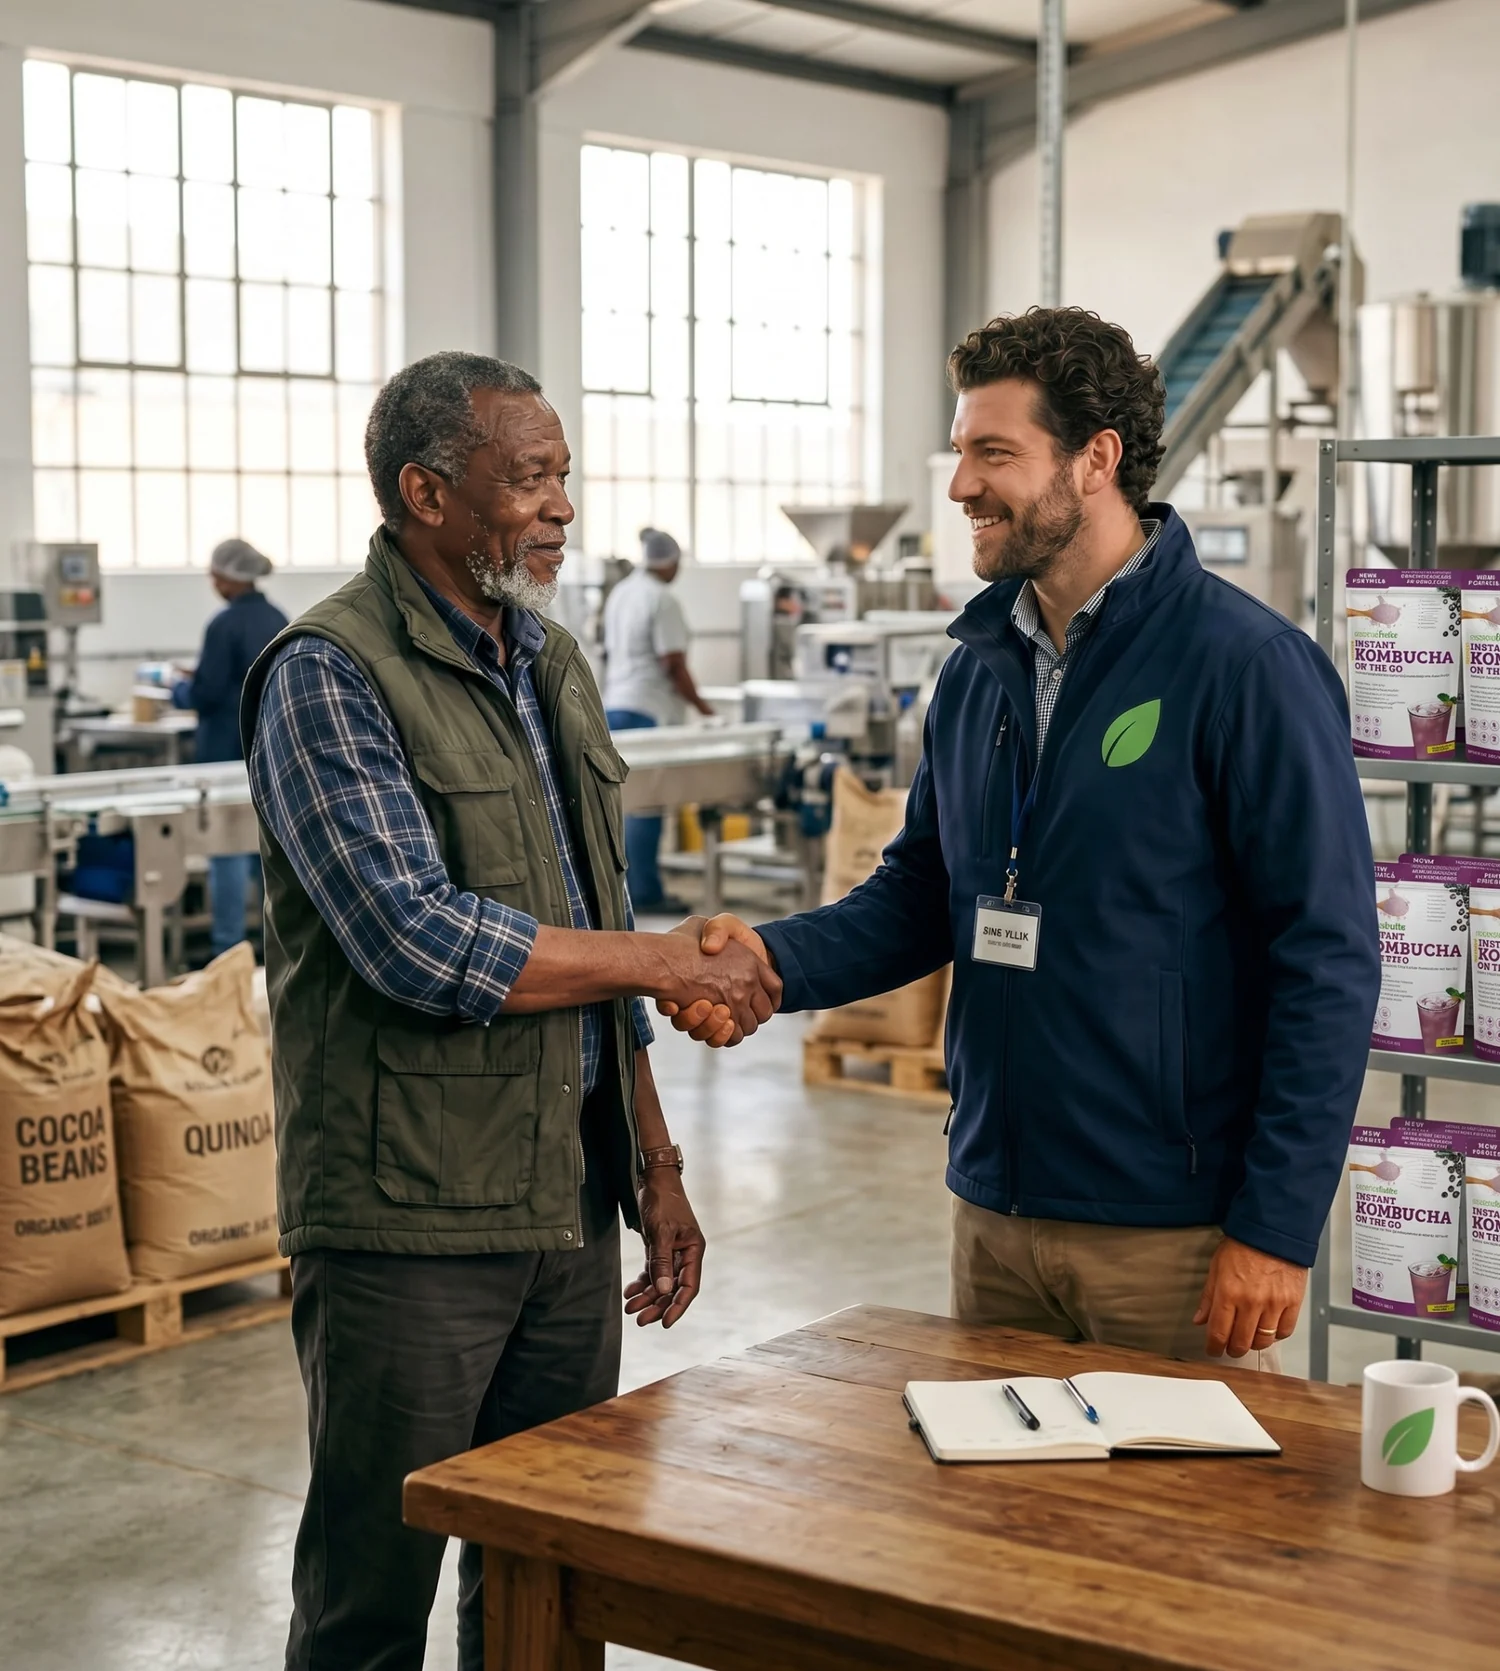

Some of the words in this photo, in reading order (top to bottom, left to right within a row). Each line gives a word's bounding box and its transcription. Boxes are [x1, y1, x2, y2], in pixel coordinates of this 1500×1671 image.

[1355, 640, 1396, 649] INSTANT
[1355, 648, 1454, 664] KOMBUCHA
[1470, 652, 1500, 665] KO
[1370, 664, 1387, 673] THE
[1389, 665, 1403, 673] GO
[1470, 666, 1483, 674] ON
[1478, 962, 1490, 971] ON
[15, 1106, 105, 1148] COCOA
[20, 1142, 107, 1185] BEANS
[1356, 1192, 1396, 1205] INSTANT
[1356, 1201, 1452, 1224] KOMBUCHA
[1355, 1215, 1367, 1223] ON
[1388, 1221, 1401, 1229] GO
[1472, 1230, 1484, 1239] ON
